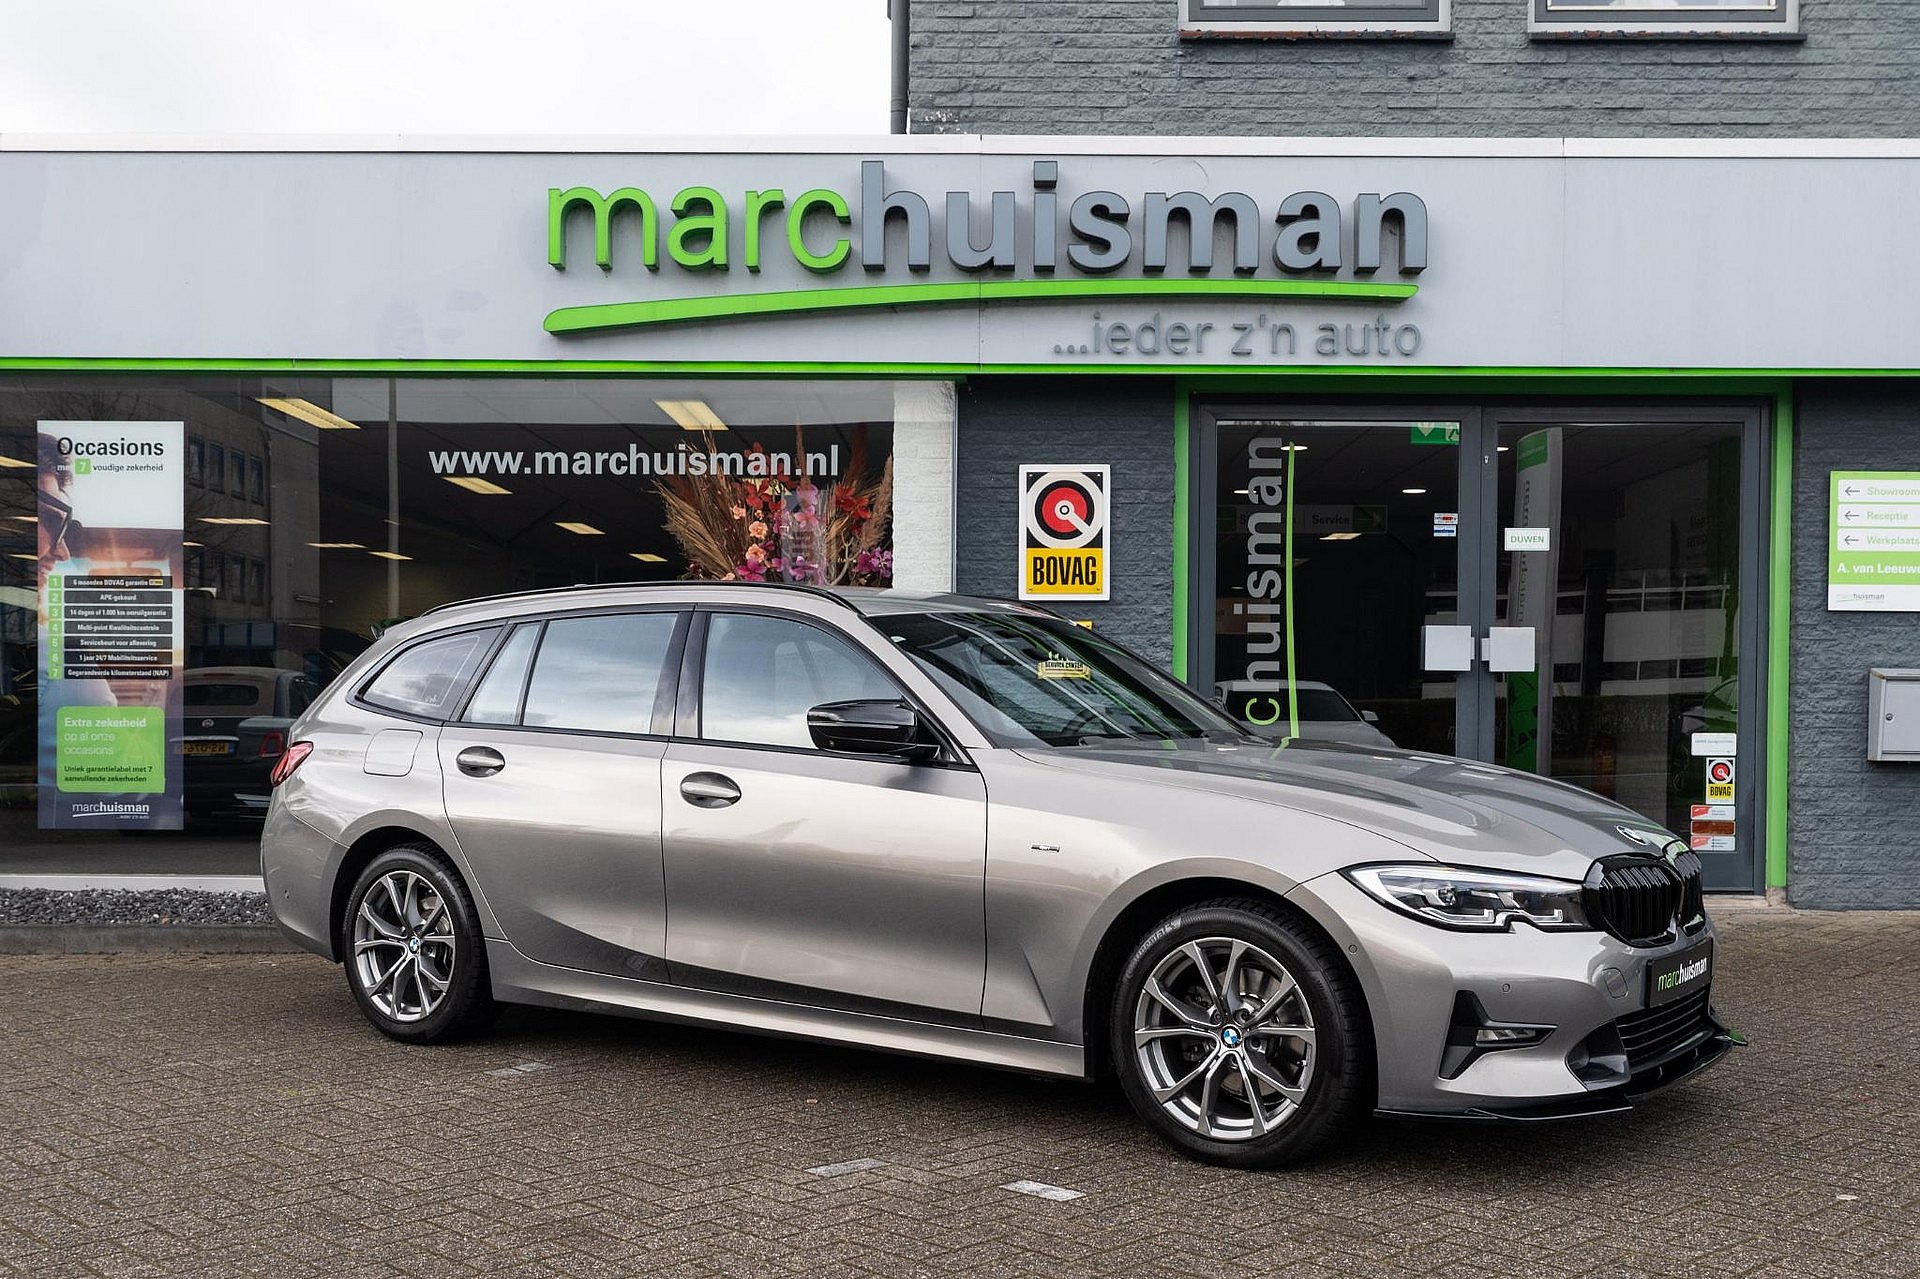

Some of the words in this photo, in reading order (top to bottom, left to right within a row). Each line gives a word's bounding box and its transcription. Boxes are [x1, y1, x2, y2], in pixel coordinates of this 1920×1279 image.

[547, 160, 1429, 275] marchuisman
[1231, 313, 1296, 355] z'n
[1316, 313, 1422, 356] auto
[57, 437, 164, 456] Occasions
[428, 443, 839, 476] www.marchuisman.nl
[93, 463, 124, 473] voudige
[126, 463, 164, 471] zekerheid
[1867, 487, 1920, 496] Showroom
[1311, 513, 1350, 525] Service
[1866, 511, 1908, 522] Receptie
[1510, 535, 1545, 544] DUWEN
[1866, 536, 1920, 546] Werkplaats
[1032, 556, 1097, 586] BOVAG
[1837, 562, 1849, 573] A.
[1853, 565, 1873, 574] van
[64, 717, 92, 728] Extra
[95, 717, 146, 728] zekerheid
[64, 746, 114, 755] occasions
[64, 765, 84, 773] Uniek
[85, 765, 132, 774] garantielabel
[1710, 786, 1732, 796] BOVAG
[72, 802, 150, 812] marchuisman
[1657, 957, 1708, 991] marchuisman
